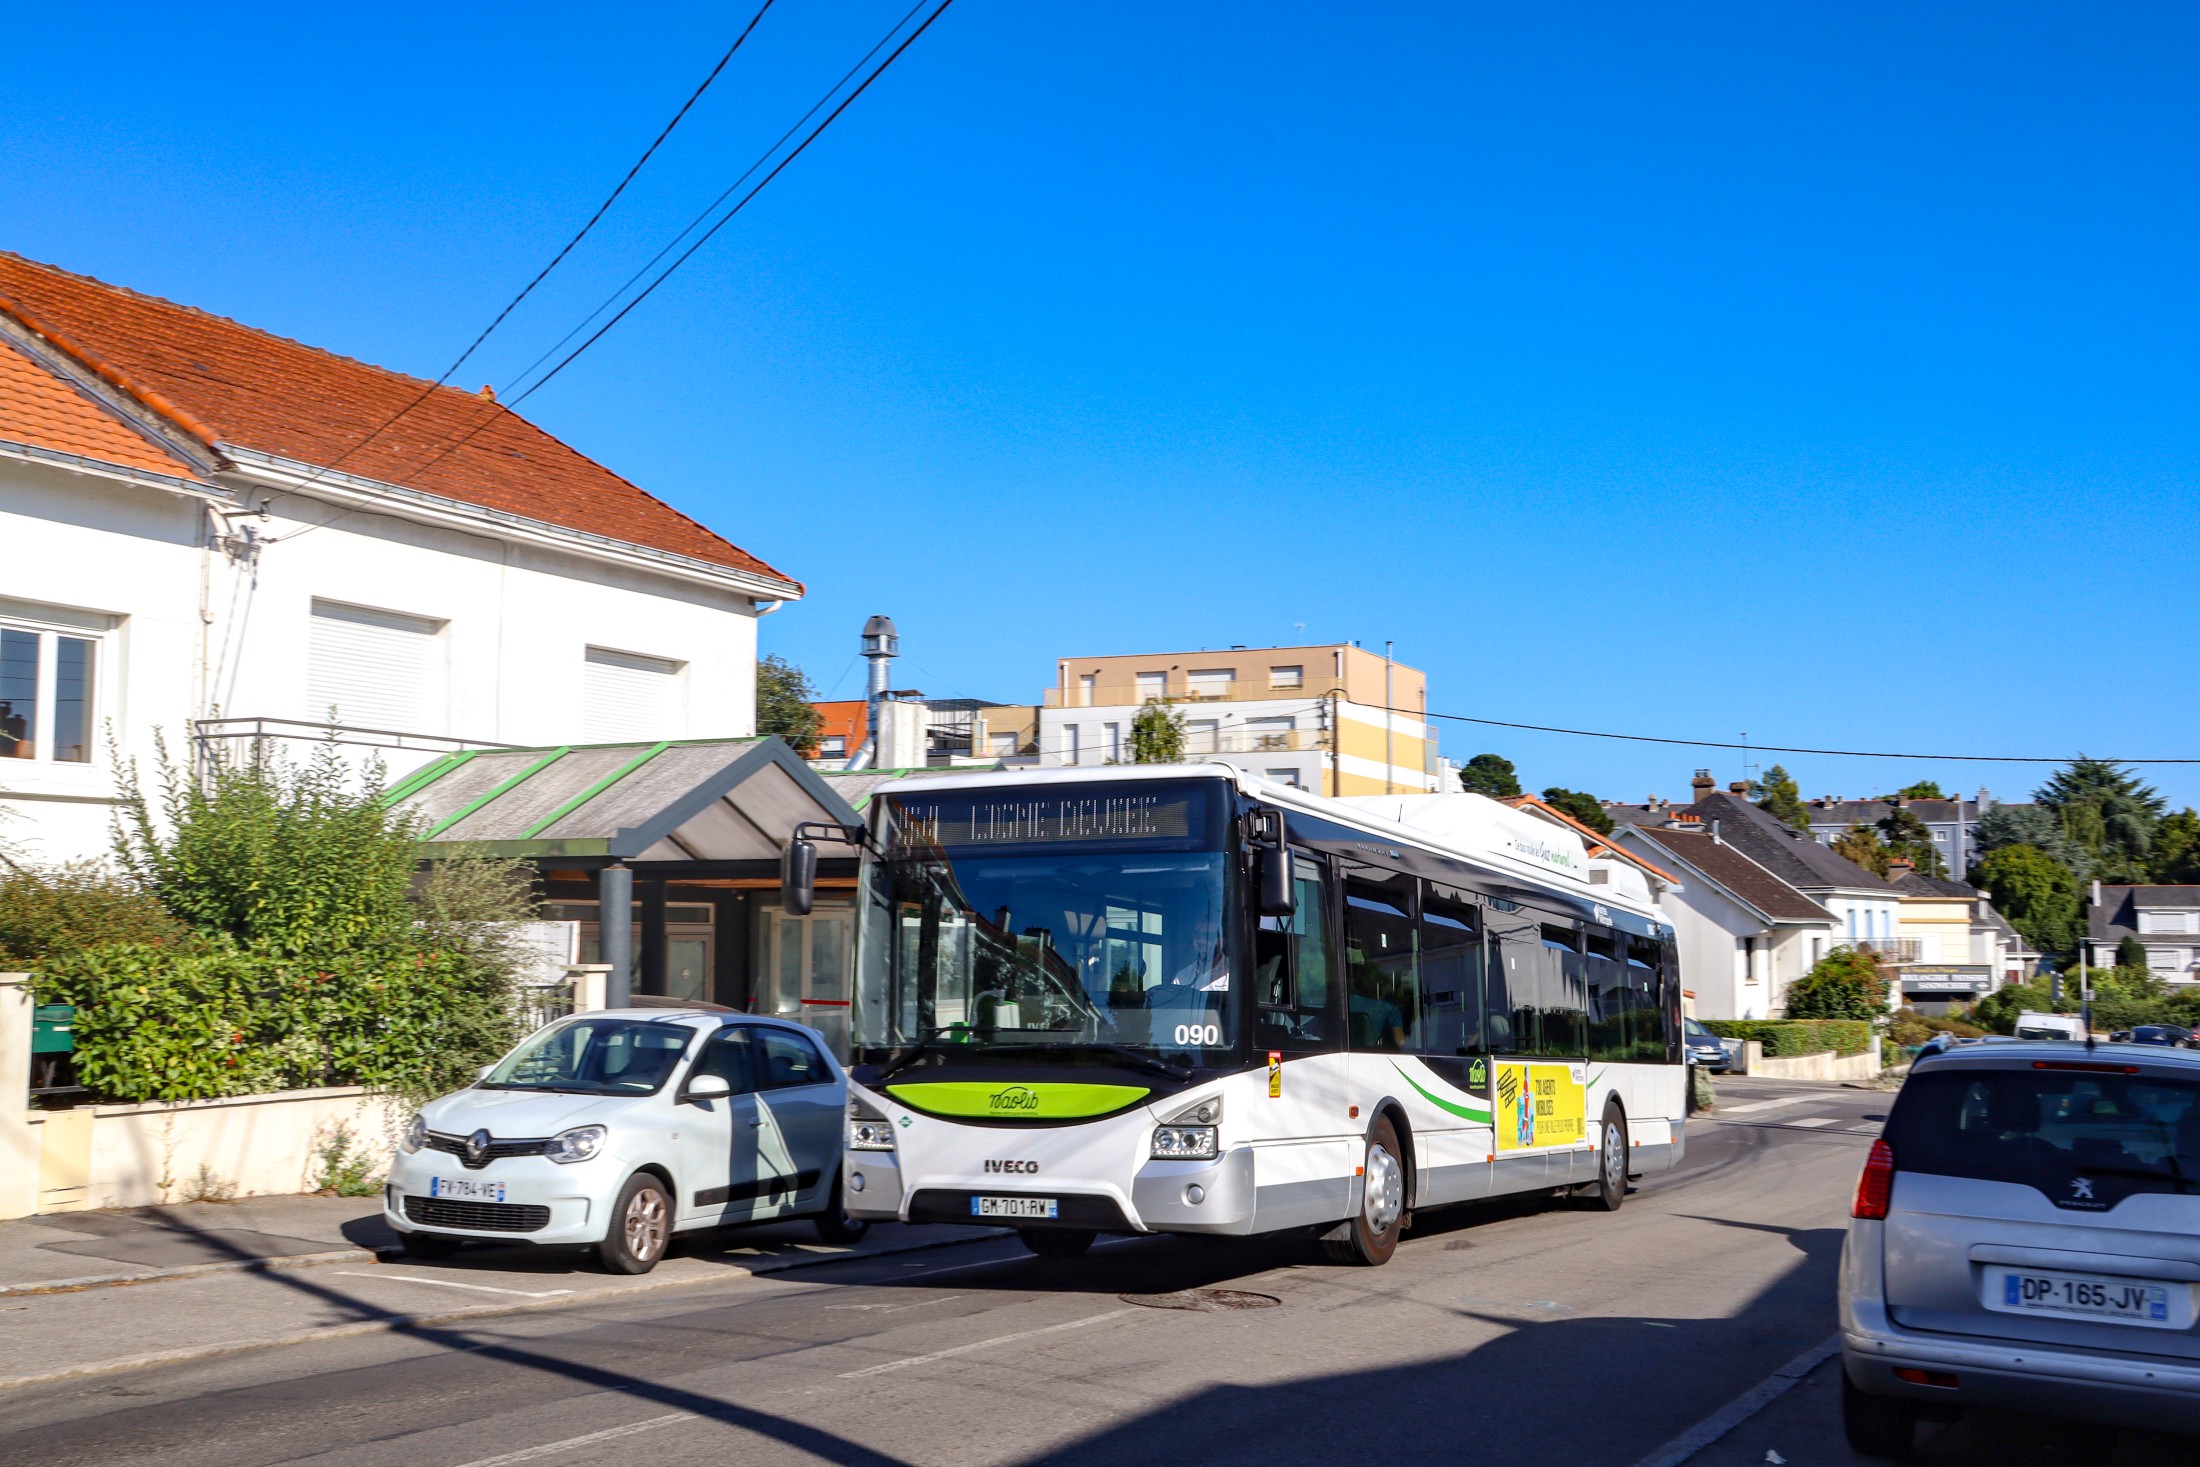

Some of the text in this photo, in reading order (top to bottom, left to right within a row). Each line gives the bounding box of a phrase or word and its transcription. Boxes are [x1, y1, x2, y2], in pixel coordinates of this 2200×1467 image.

[1174, 1024, 1219, 1046] 090
[984, 1160, 1039, 1174] IVECO
[2023, 1277, 2146, 1311] DP-165-JV
